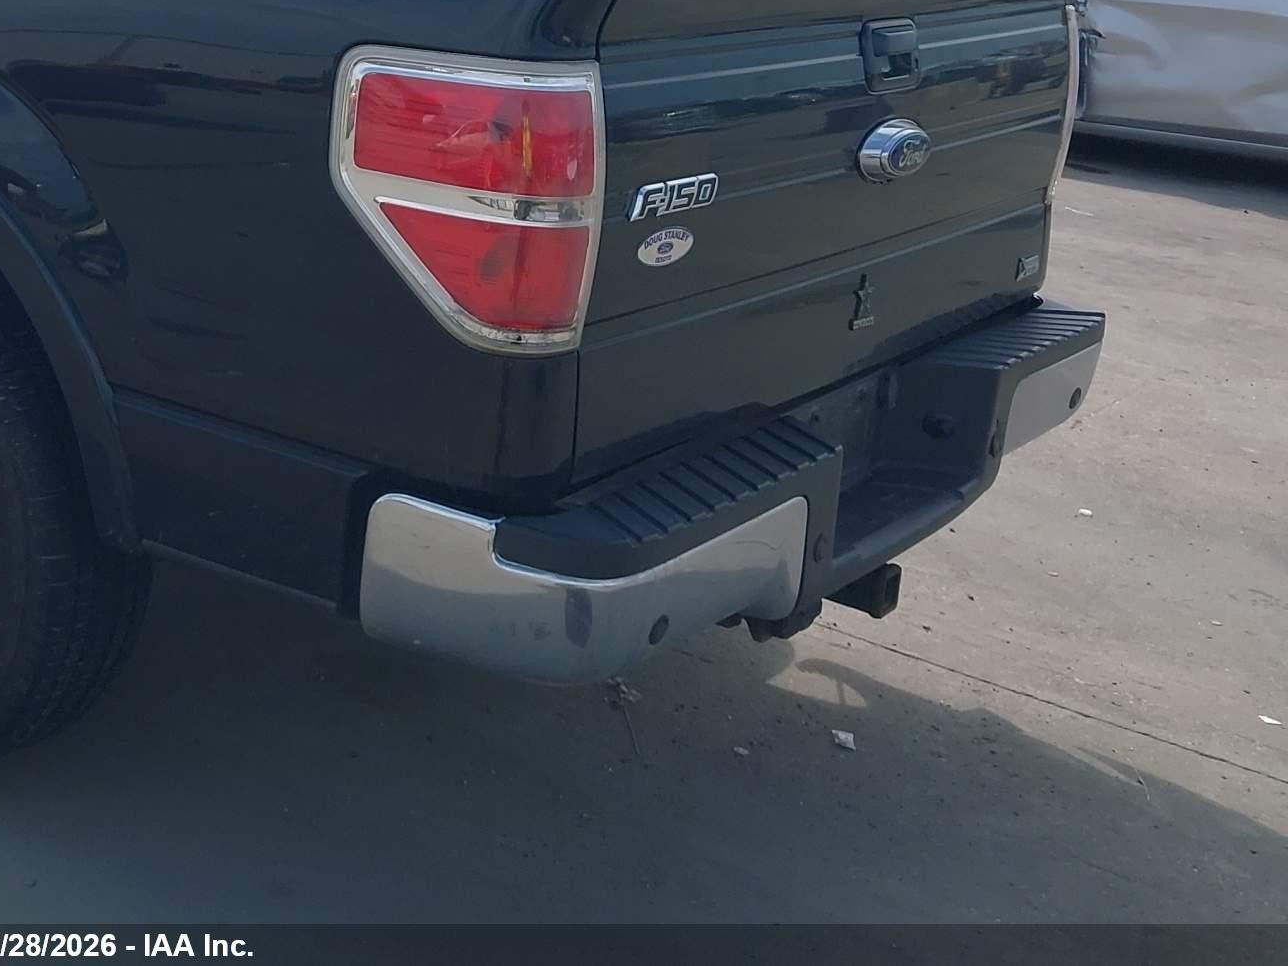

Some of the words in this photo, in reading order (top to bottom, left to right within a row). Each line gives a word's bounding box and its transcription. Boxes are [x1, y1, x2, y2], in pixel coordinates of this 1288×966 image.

[899, 139, 928, 167] Ford
[630, 172, 719, 222] F-150
[644, 232, 663, 250] DOUG
[663, 230, 690, 242] STANLEY
